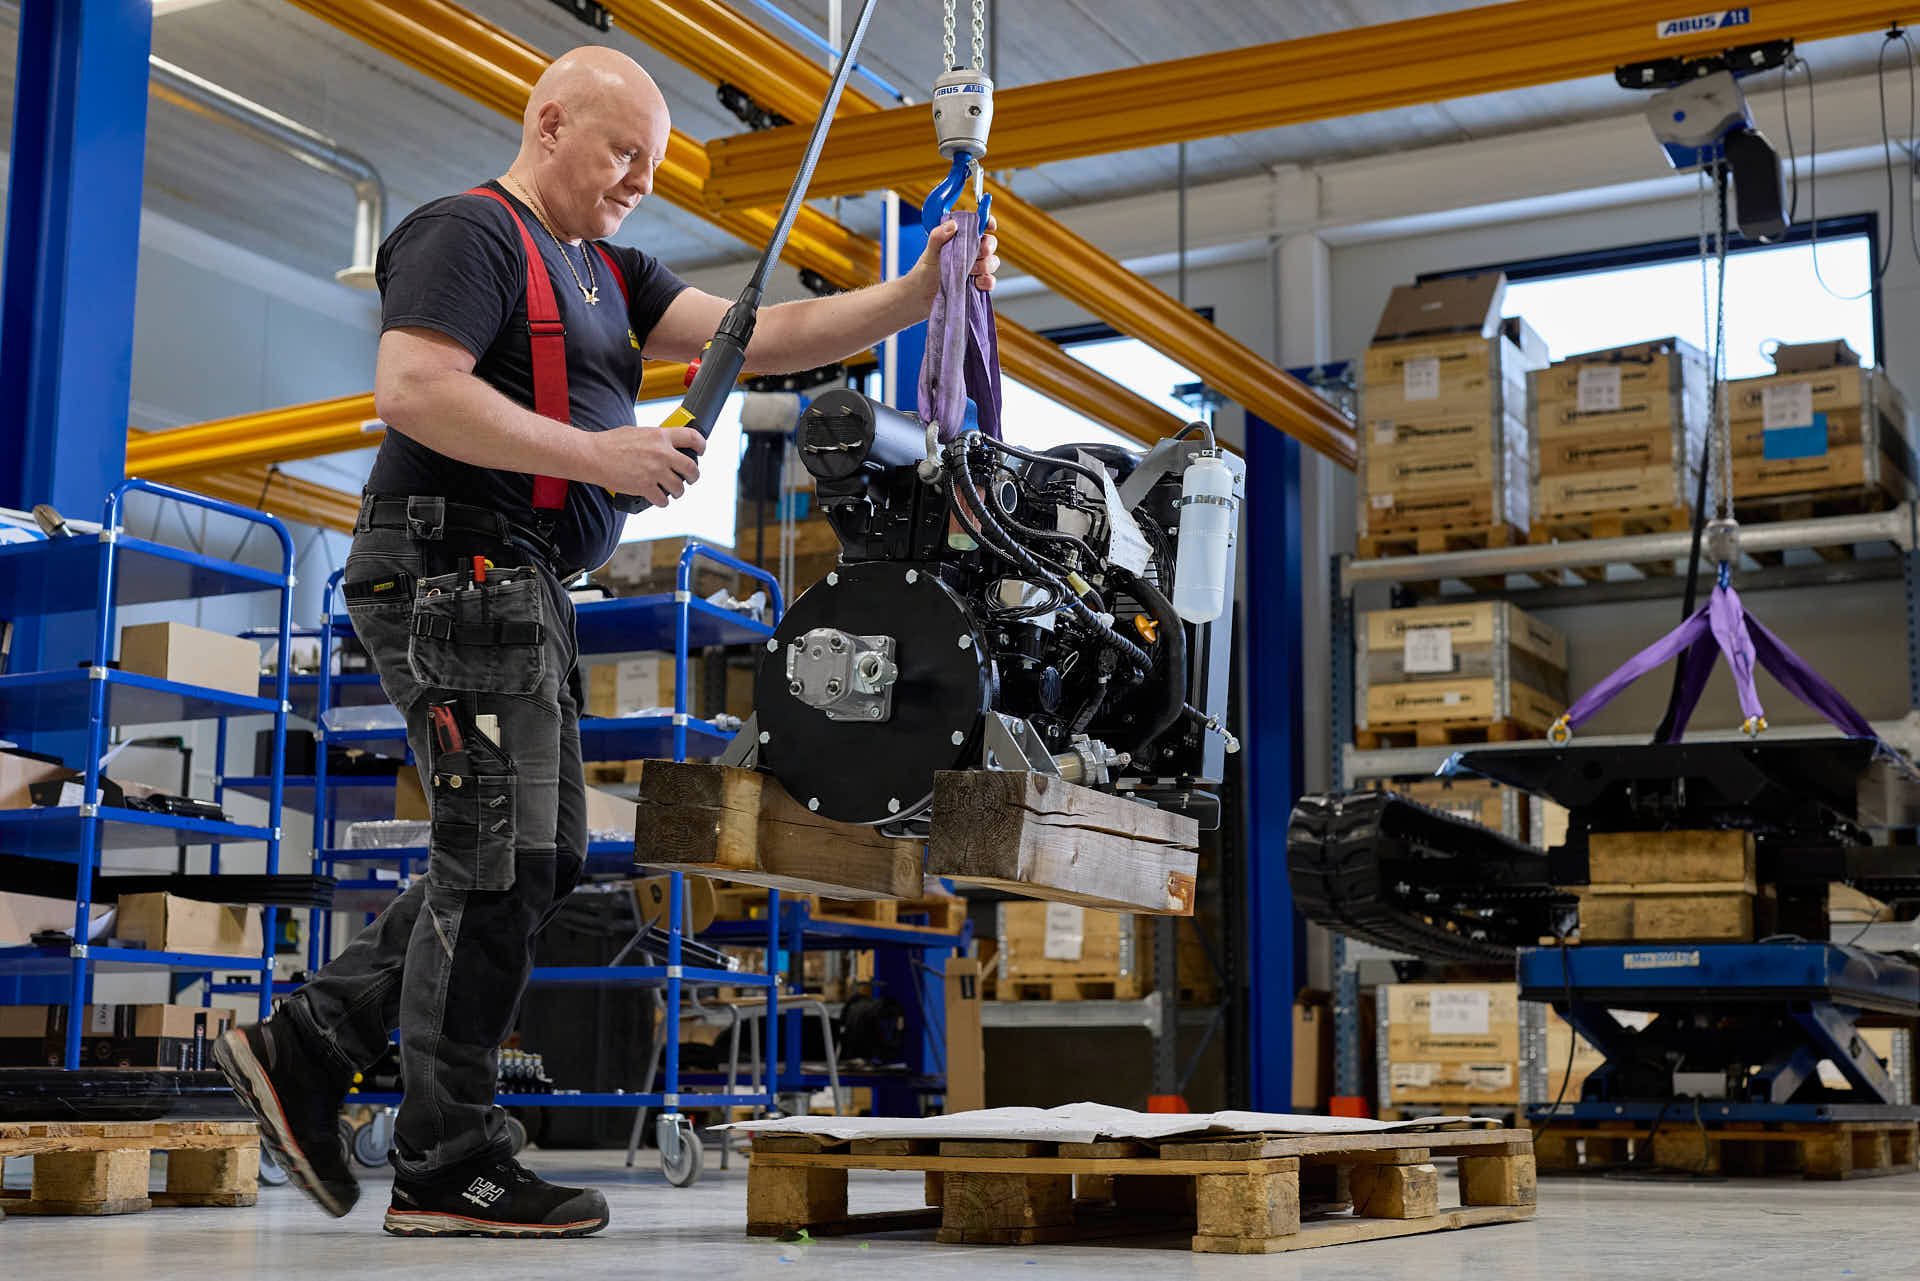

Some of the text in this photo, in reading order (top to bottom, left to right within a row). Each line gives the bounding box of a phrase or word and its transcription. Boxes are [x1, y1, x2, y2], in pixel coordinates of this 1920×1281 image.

[1663, 16, 1716, 36] ABUS
[936, 86, 959, 97] ABUS
[468, 1176, 505, 1202] HH
